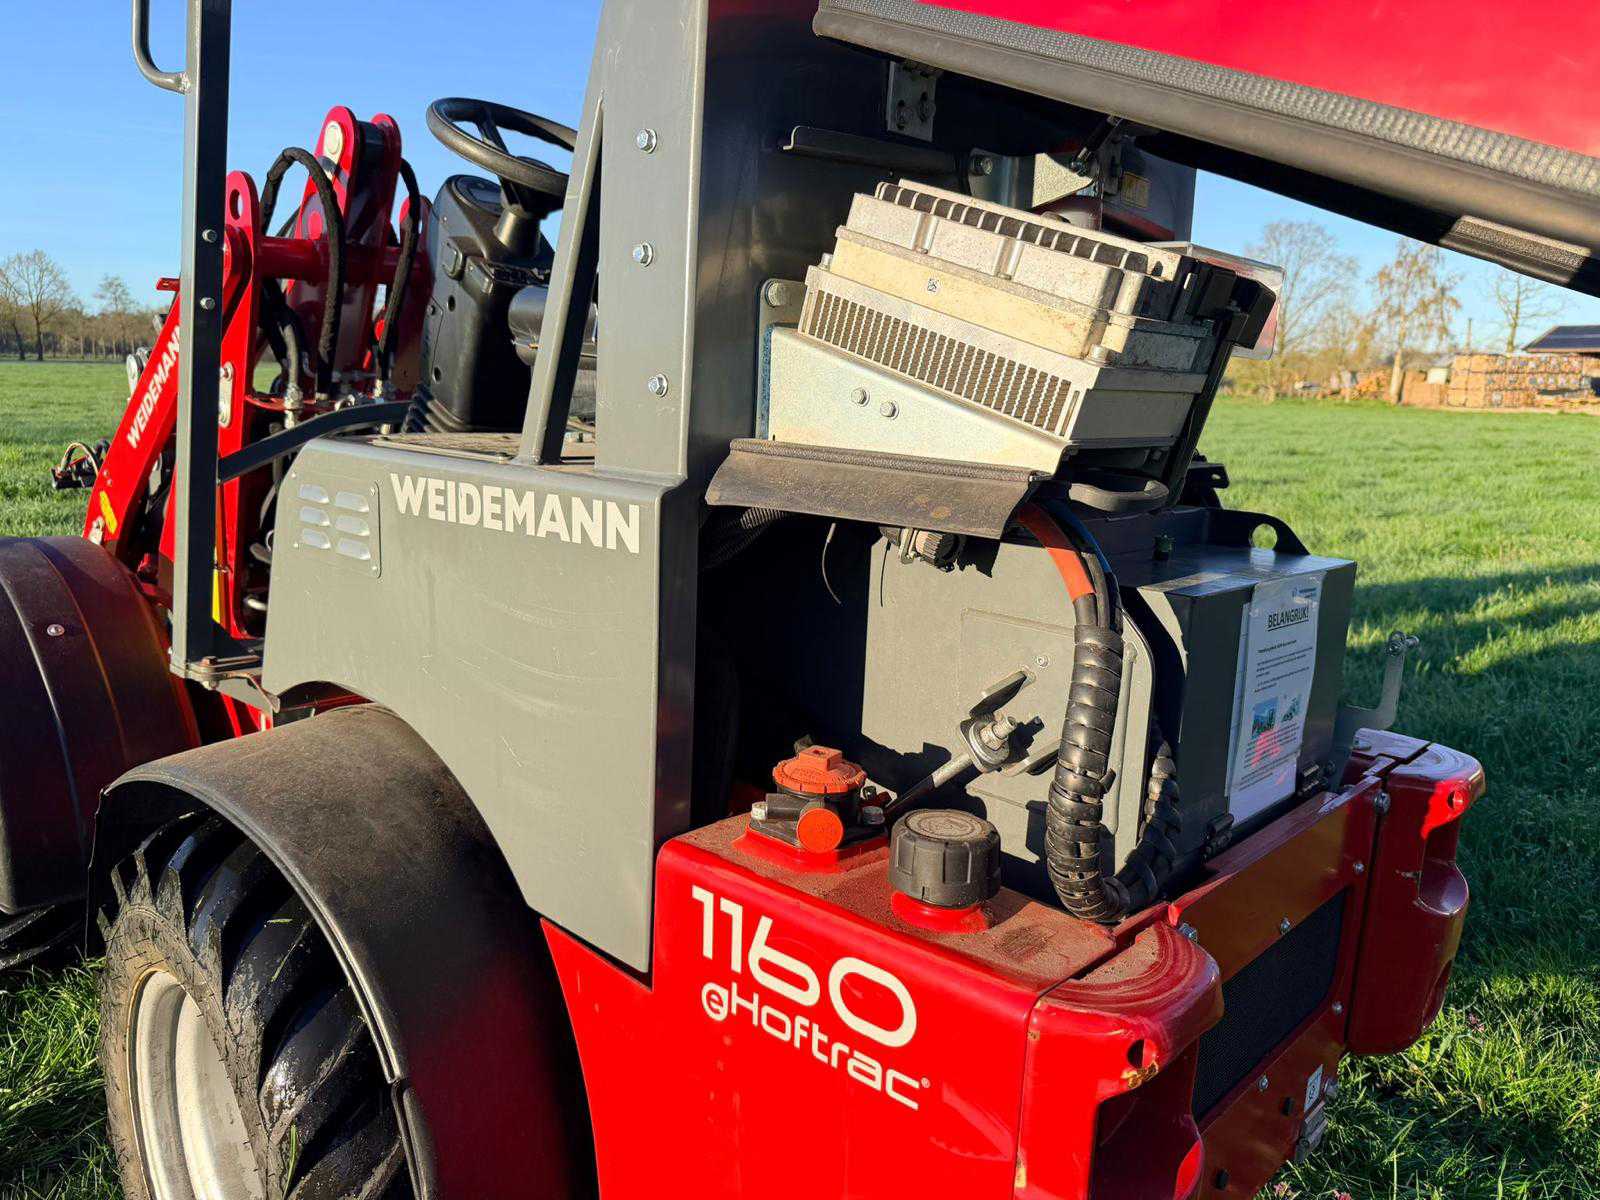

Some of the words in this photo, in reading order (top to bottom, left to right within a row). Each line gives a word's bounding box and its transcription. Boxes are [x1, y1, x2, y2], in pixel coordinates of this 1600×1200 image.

[127, 325, 180, 449] WEIDEMAN
[390, 473, 641, 554] WEIDEMANN
[692, 885, 917, 1048] 1160
